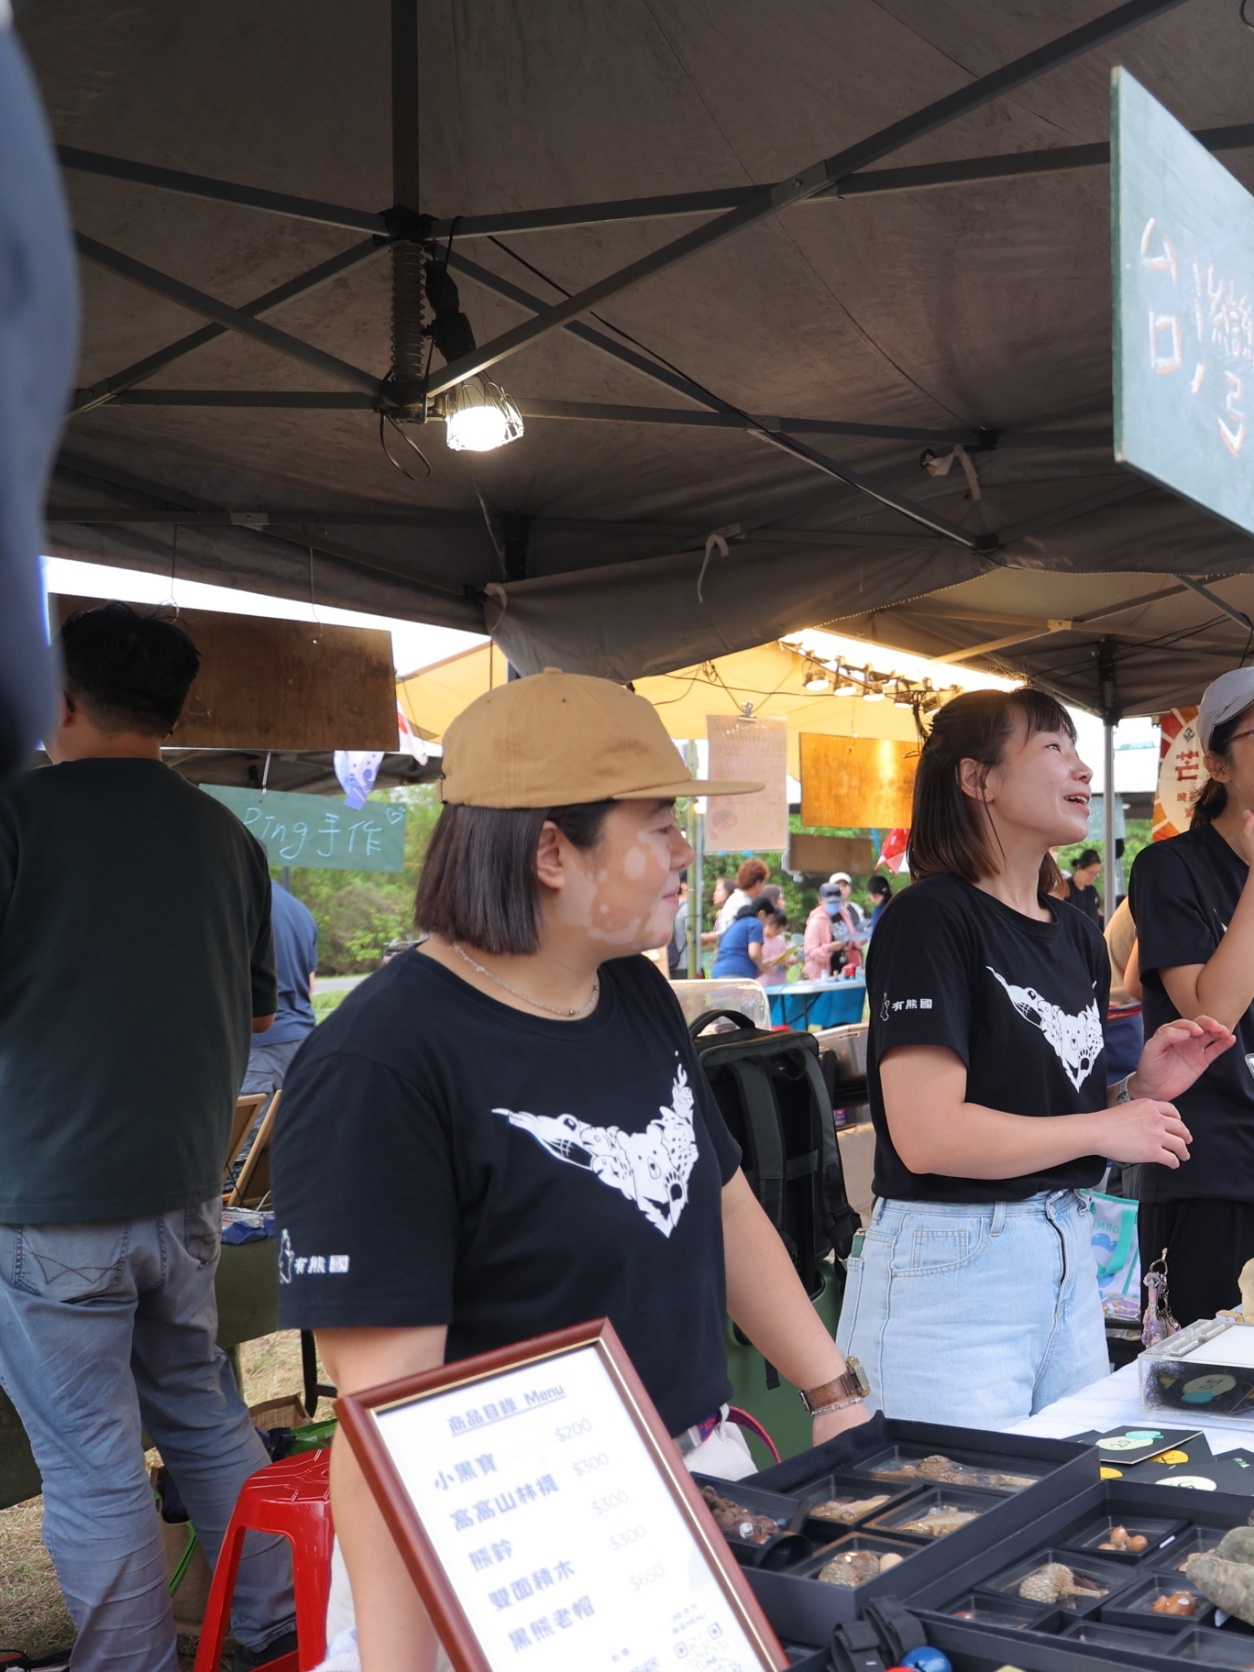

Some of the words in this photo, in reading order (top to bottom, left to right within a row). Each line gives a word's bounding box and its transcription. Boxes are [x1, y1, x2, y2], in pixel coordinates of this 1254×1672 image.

[447, 1397, 518, 1433] 商品目錄
[523, 1385, 565, 1407] Menu
[554, 1418, 592, 1443] $200
[572, 1452, 609, 1477] $300
[591, 1490, 629, 1516] $300
[609, 1524, 646, 1551] $300
